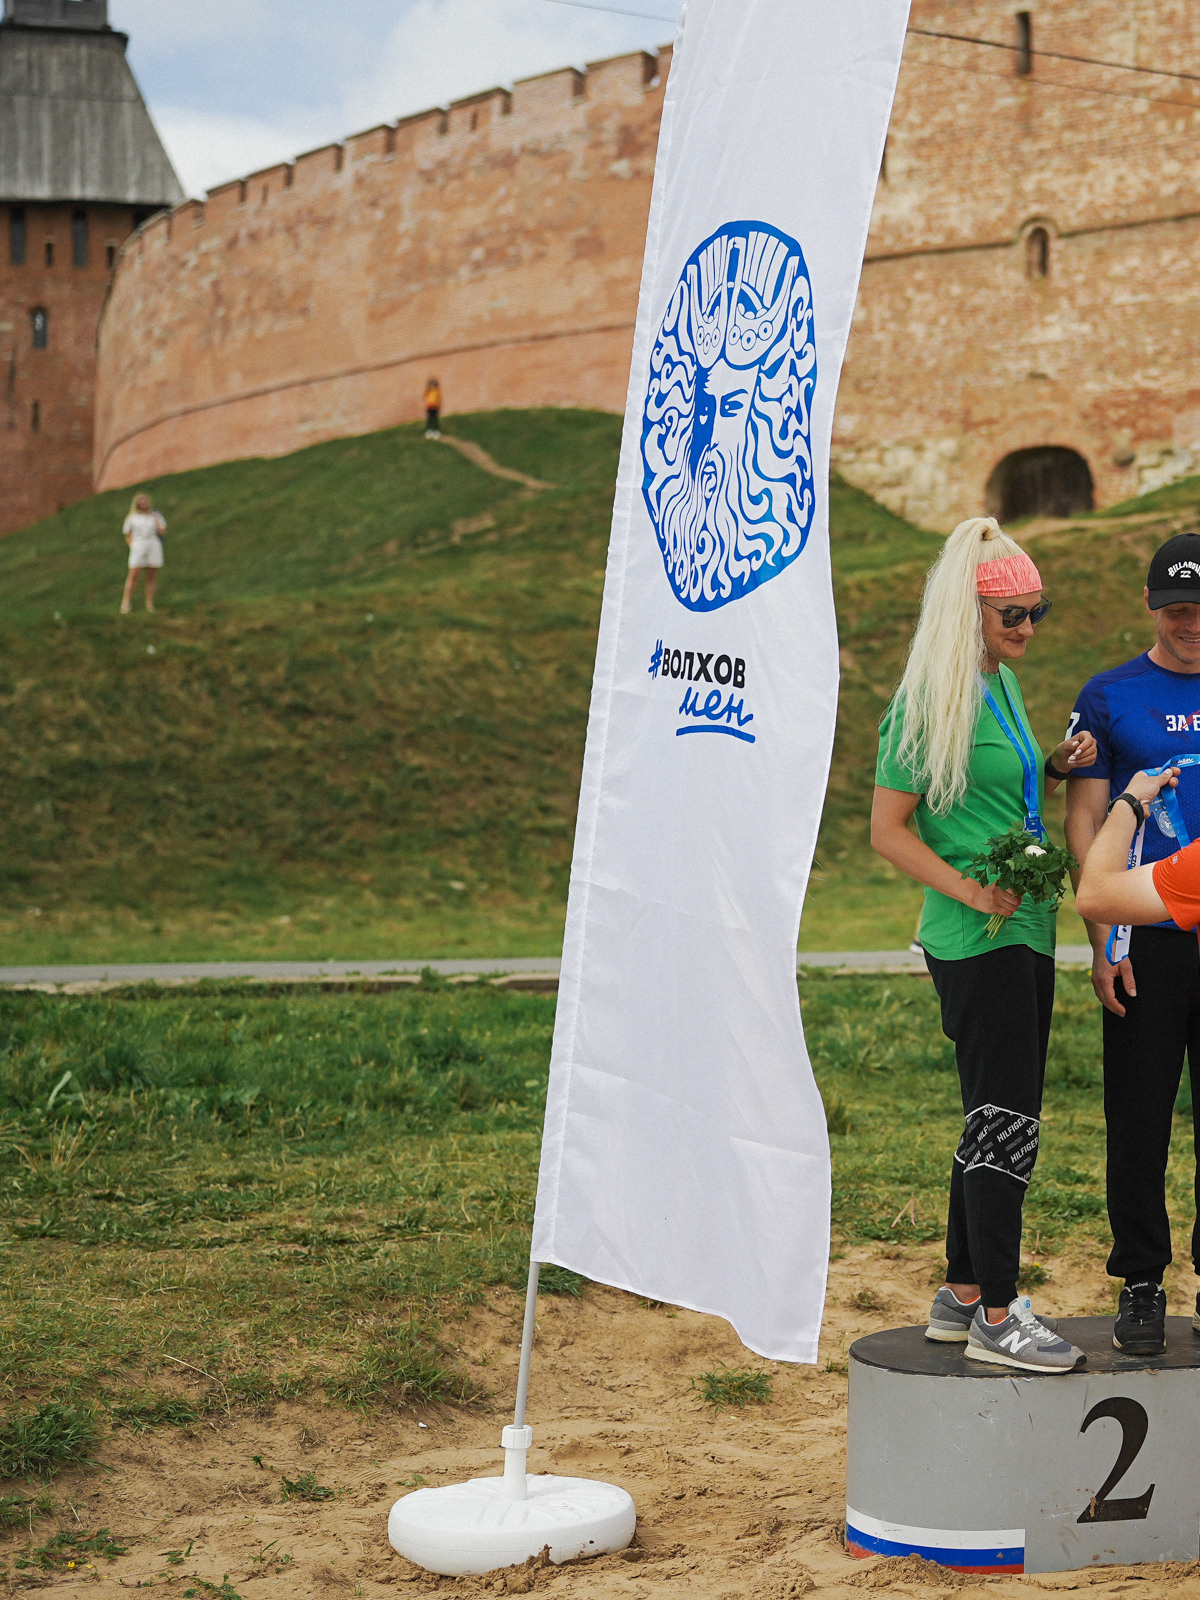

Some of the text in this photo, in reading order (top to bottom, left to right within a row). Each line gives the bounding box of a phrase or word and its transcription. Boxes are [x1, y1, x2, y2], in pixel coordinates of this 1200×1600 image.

[648, 639, 746, 689] #ВОЛХОВ
[996, 1116, 1028, 1143] HILFIGER
[1077, 1397, 1155, 1523] 2
